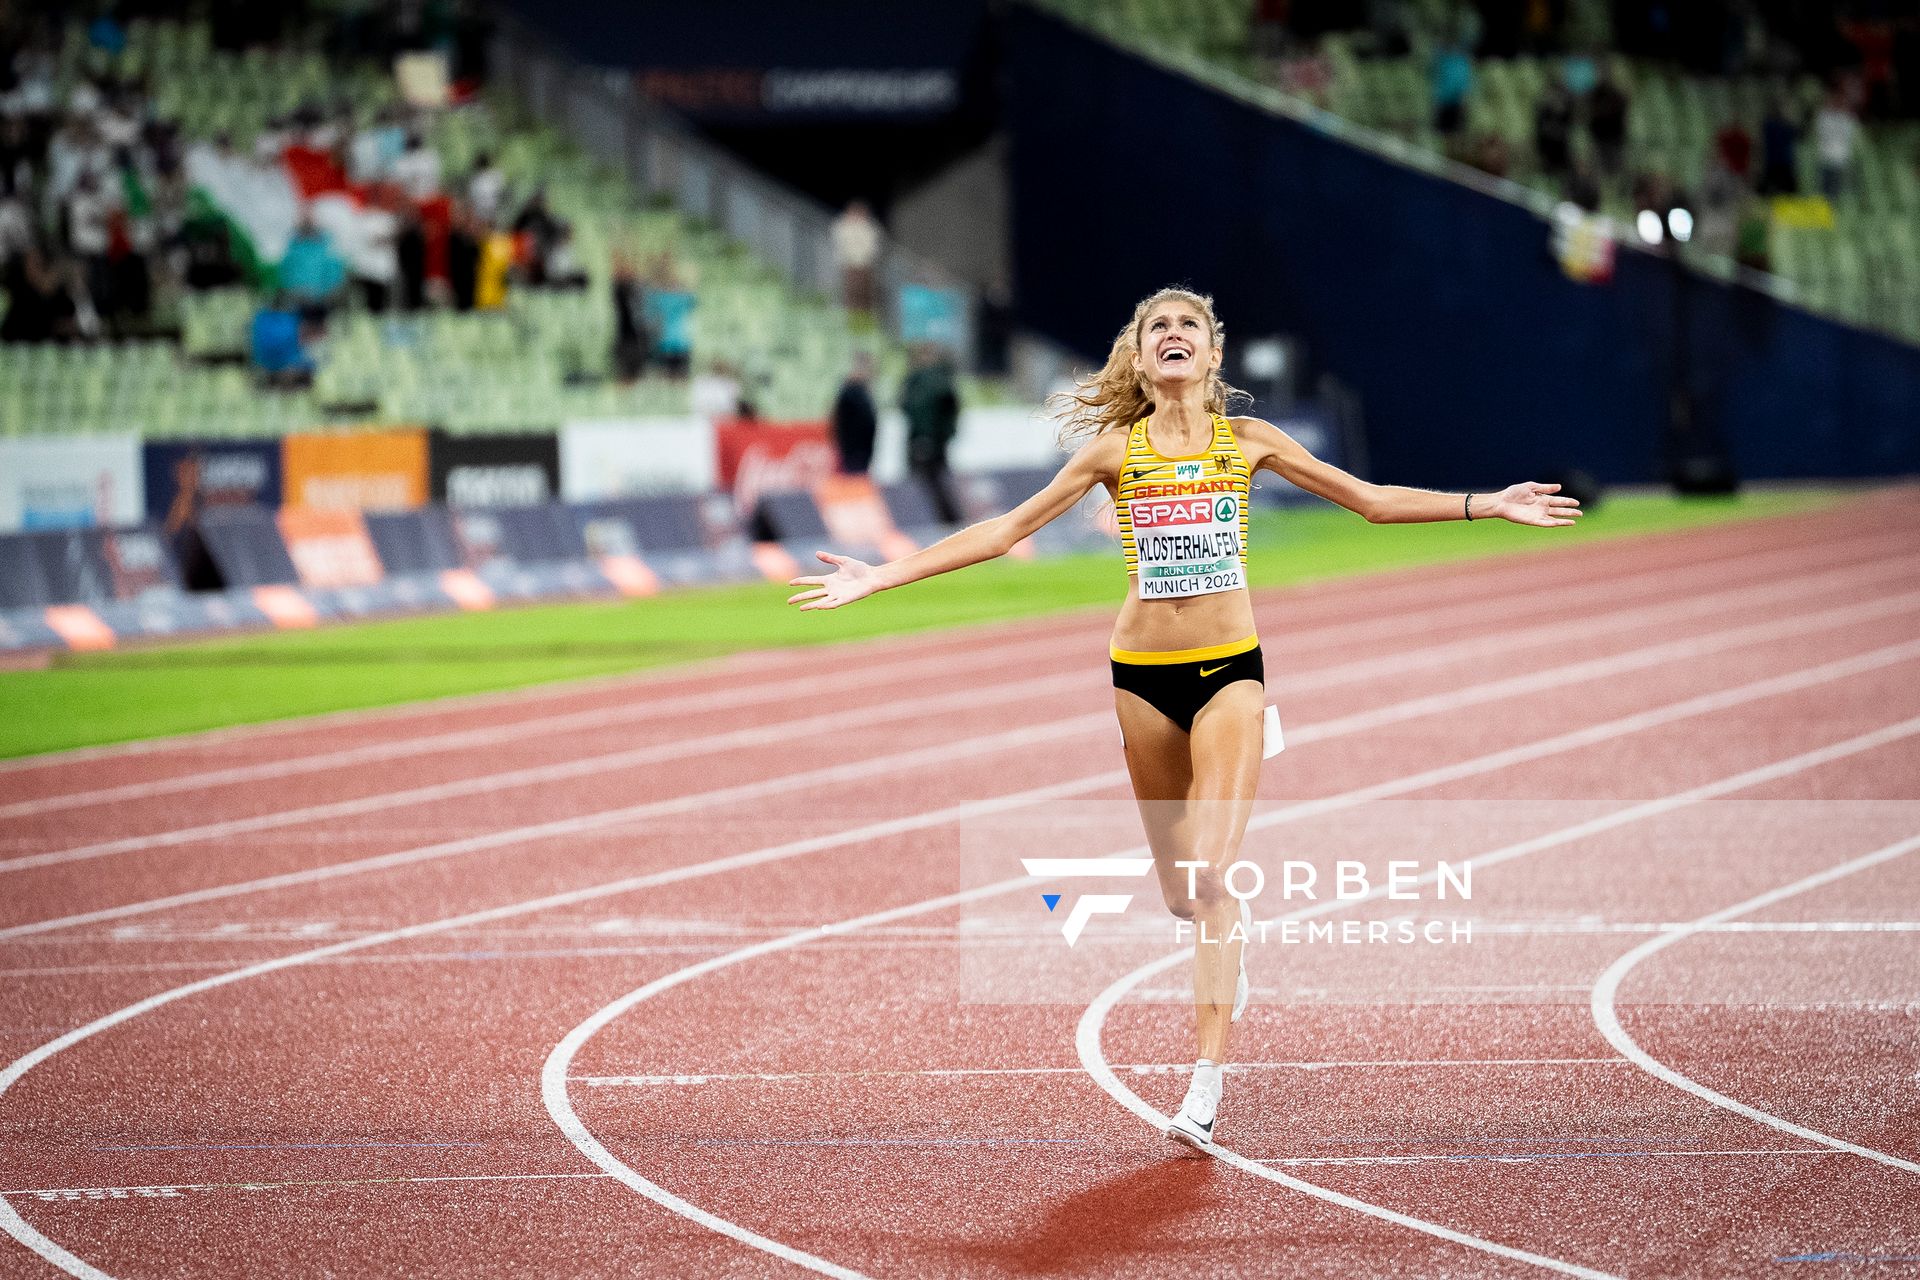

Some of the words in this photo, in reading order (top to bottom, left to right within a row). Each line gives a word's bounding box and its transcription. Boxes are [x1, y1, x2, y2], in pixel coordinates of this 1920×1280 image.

[1134, 480, 1235, 499] GERMANY
[1133, 502, 1211, 525] SPAR
[1138, 531, 1239, 561] KLOSTERHALFEN
[1163, 566, 1184, 576] RUN
[1145, 578, 1199, 594] MUNICH
[1204, 572, 1239, 589] 2022
